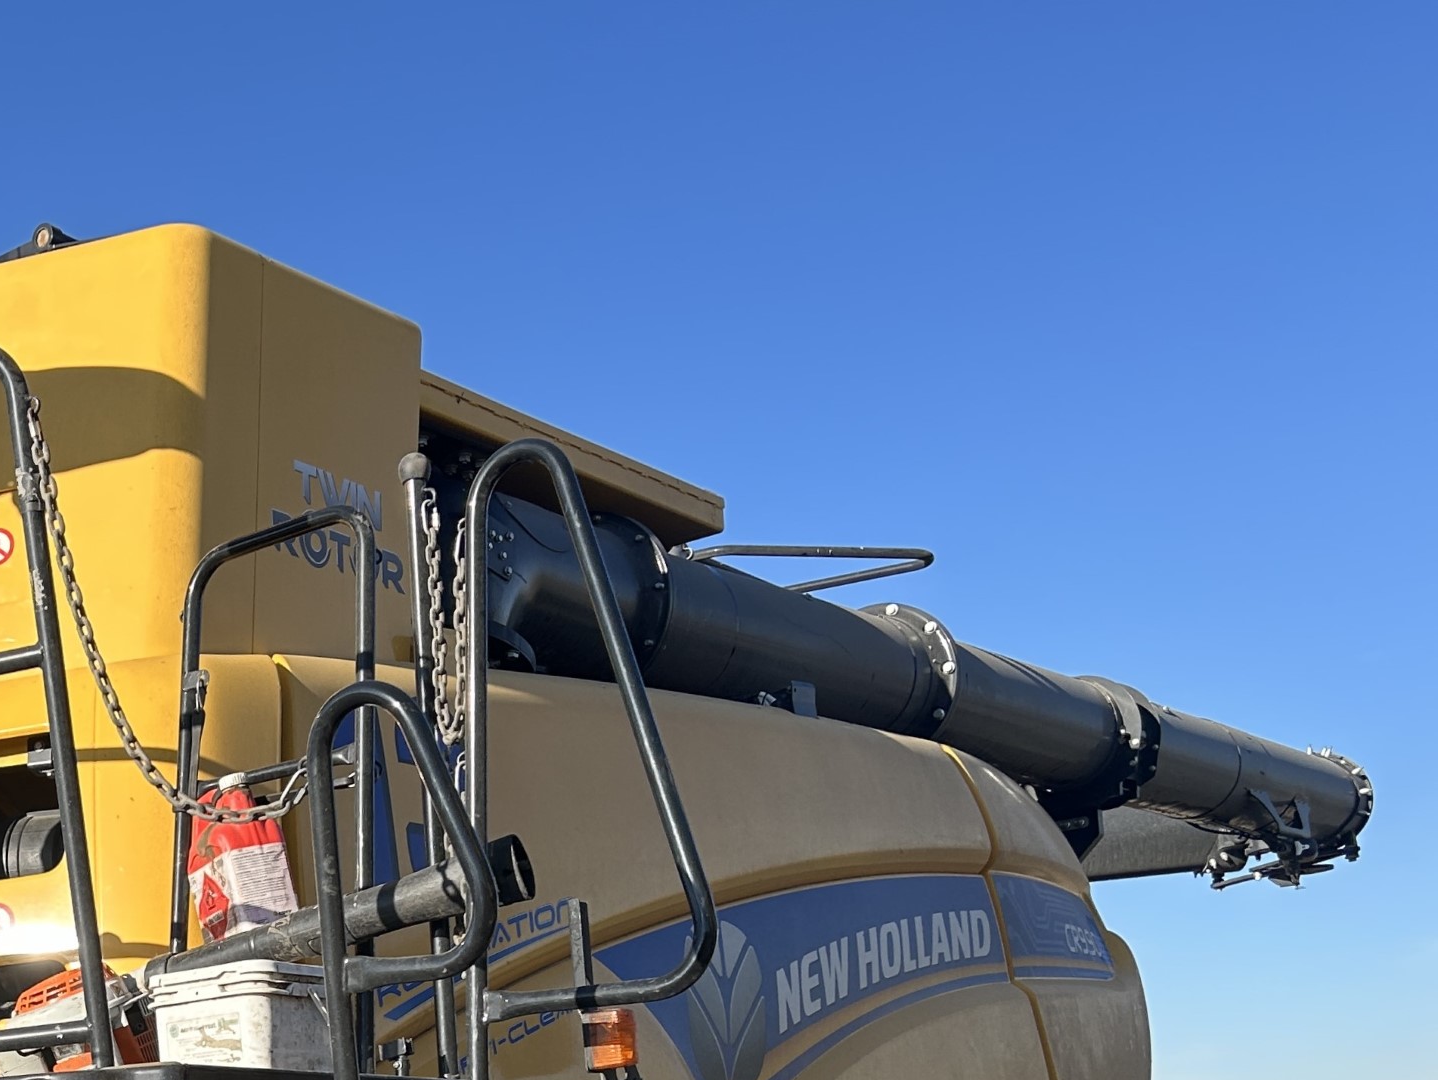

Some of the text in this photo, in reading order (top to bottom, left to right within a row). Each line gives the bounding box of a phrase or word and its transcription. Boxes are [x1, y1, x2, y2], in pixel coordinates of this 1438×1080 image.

[293, 459, 382, 532] TWIN
[270, 507, 406, 595] ROTR
[775, 909, 992, 1035] NEW HOLLAND
